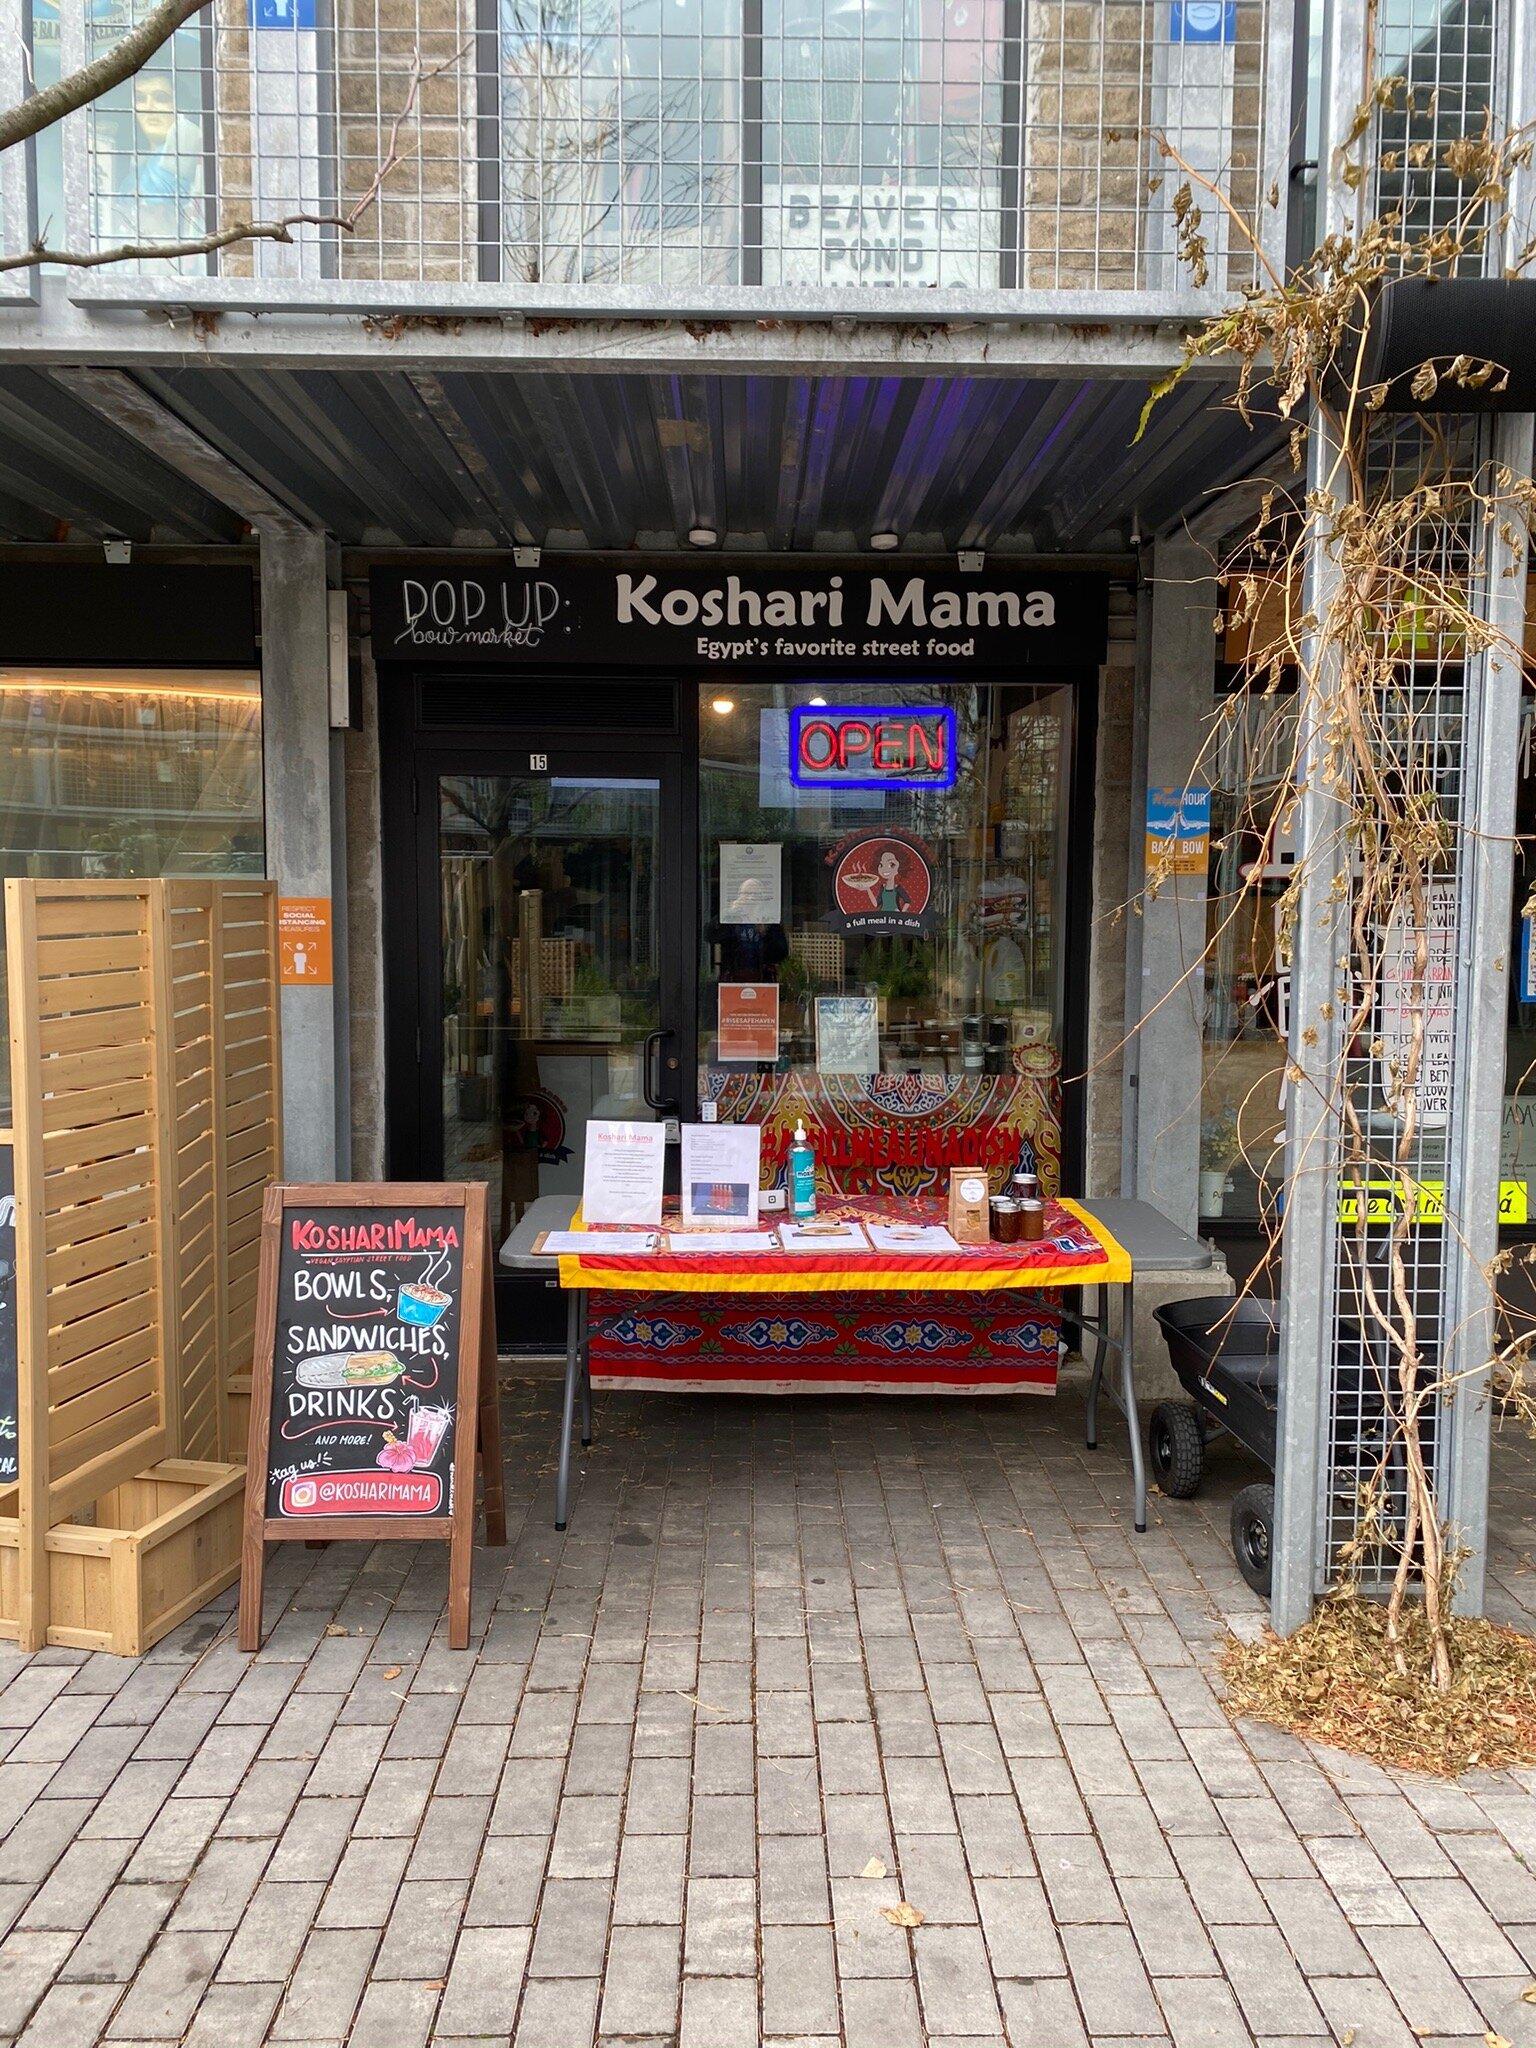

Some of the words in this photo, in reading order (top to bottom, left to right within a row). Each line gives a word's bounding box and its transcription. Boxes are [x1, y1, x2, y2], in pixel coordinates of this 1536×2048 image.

[789, 194, 958, 230] BEAVER
[824, 237, 924, 272] POND
[403, 580, 486, 626] POP
[615, 573, 844, 627] Koshari
[866, 577, 1056, 628] Mama
[394, 613, 460, 645] bow
[456, 622, 545, 648] market
[697, 637, 768, 659] Egypt's
[775, 637, 856, 656] favorite
[862, 638, 920, 656] street
[926, 638, 975, 656] food
[531, 754, 547, 770] 15
[800, 721, 944, 771] OPEN
[1183, 793, 1206, 805] HOUR
[1183, 841, 1204, 854] BOW
[846, 919, 851, 928] a
[852, 917, 866, 927] full
[867, 916, 887, 925] meal
[888, 916, 896, 925] in
[904, 918, 921, 928] dish
[597, 1132, 628, 1142] Koshari
[628, 1133, 653, 1142] Mama
[334, 1256, 365, 1264] EGYPTIAN
[366, 1255, 392, 1263] STREET
[395, 1255, 412, 1263] FOOD
[294, 1268, 392, 1303] BOWLS,
[286, 1323, 449, 1360] SANDWICHES,
[288, 1388, 397, 1420] DRINKS
[339, 1434, 373, 1446] MORE!
[273, 1464, 299, 1484] tag
[300, 1452, 322, 1471] us!
[319, 1482, 431, 1502] @KOSHARIMAMA
